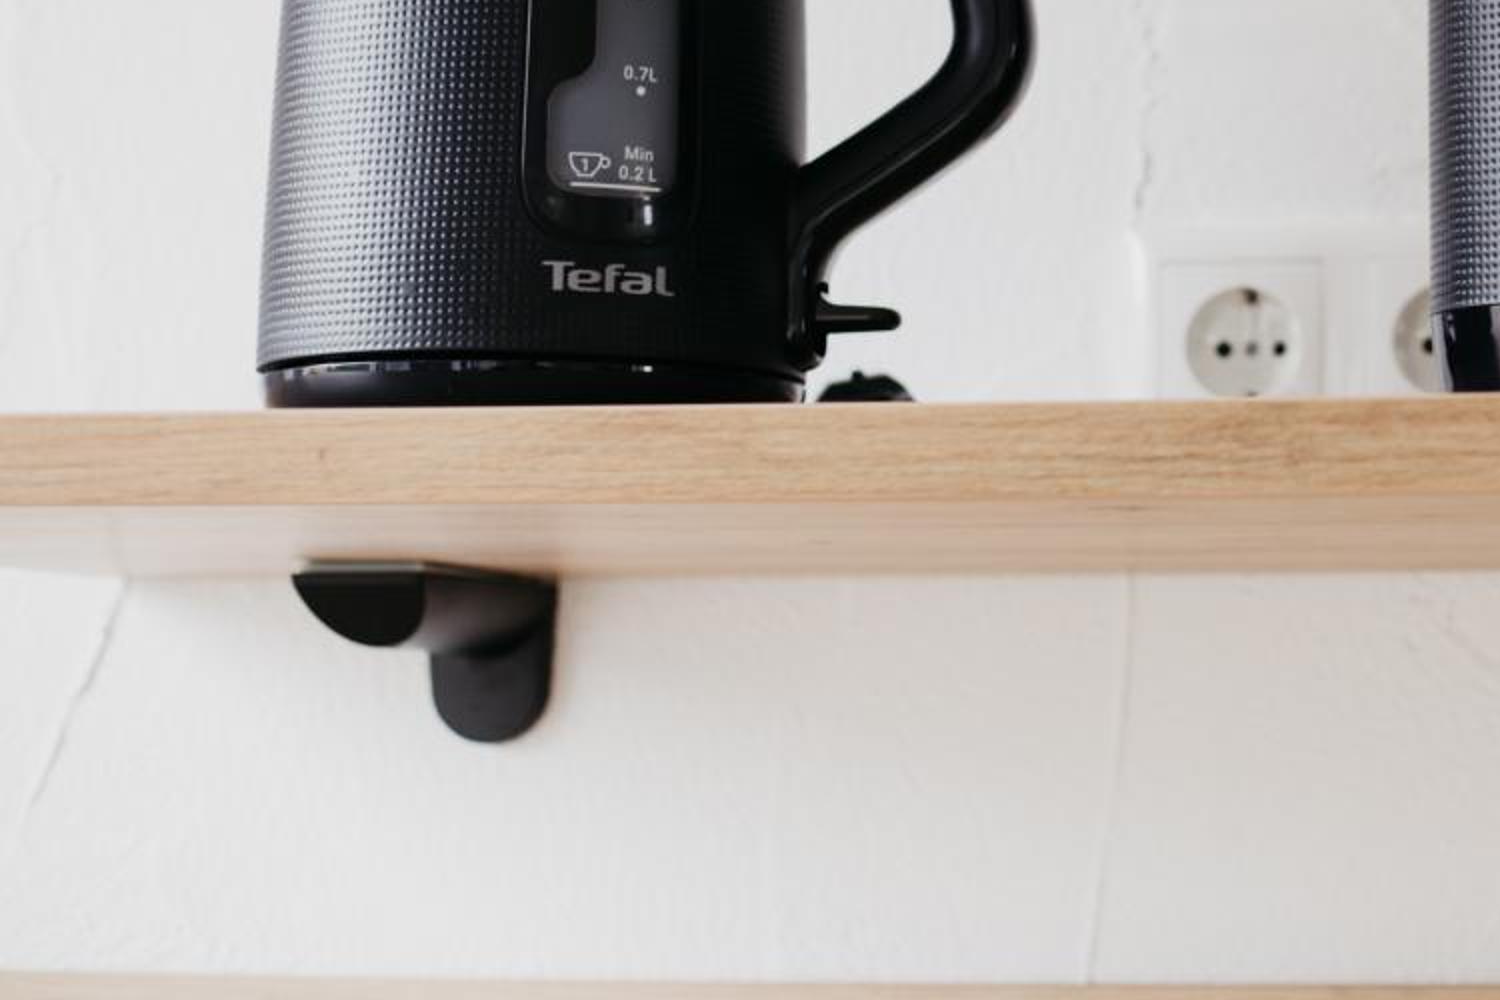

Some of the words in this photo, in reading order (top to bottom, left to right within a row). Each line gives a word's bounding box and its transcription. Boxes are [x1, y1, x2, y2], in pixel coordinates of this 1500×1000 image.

[623, 64, 657, 83] 0.7L
[624, 145, 654, 162] Min
[542, 260, 675, 298] Tefal
